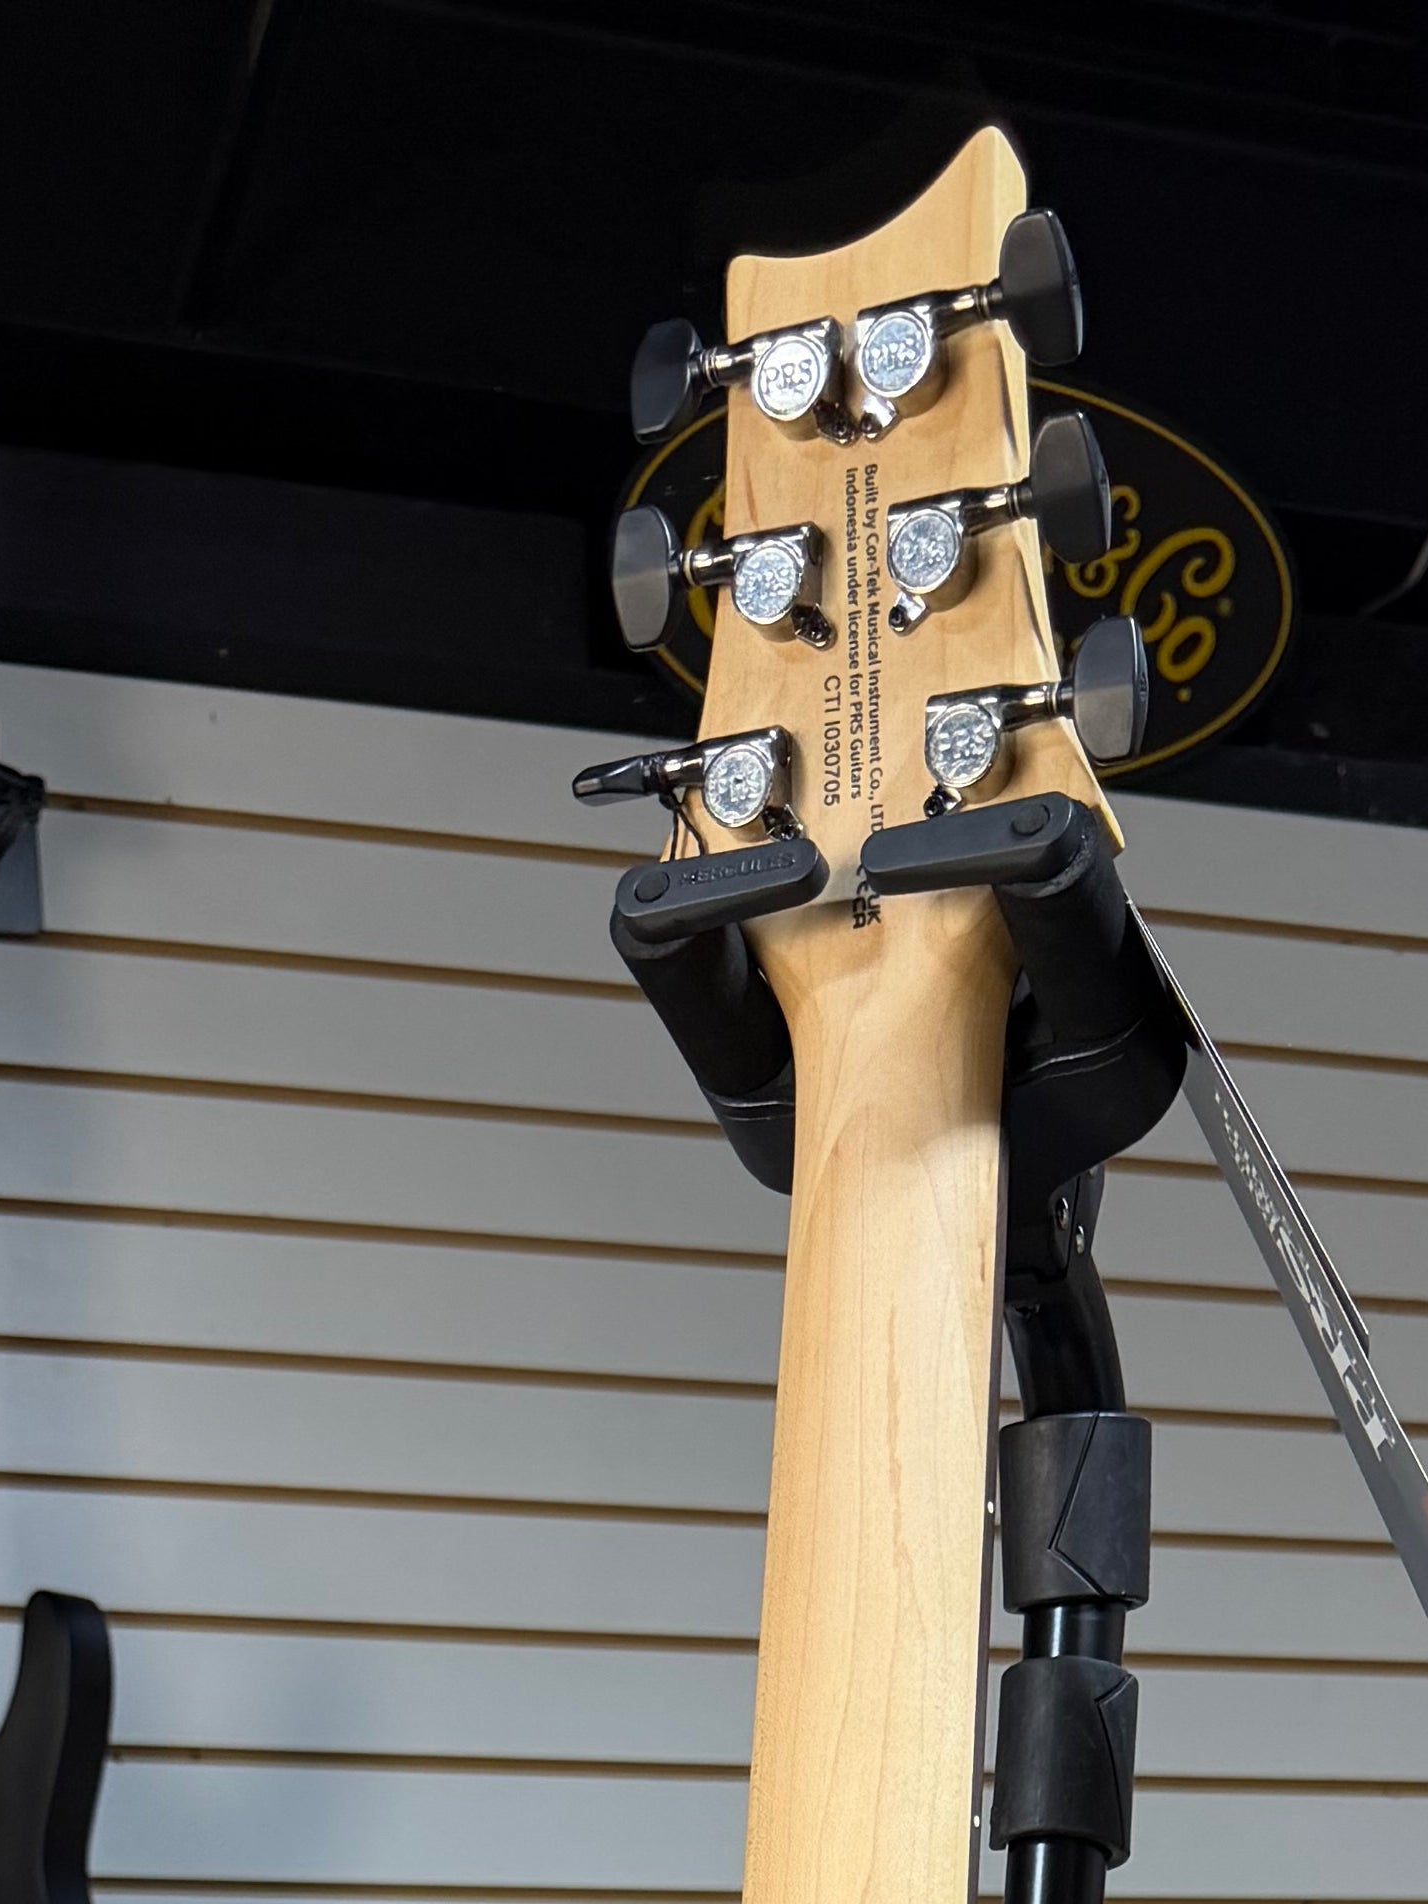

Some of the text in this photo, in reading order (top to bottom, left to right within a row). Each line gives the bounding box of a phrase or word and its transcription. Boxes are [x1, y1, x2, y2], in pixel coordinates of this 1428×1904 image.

[762, 358, 813, 396] PRS
[864, 463, 879, 503] Built
[862, 508, 879, 531] by
[865, 532, 881, 599] Cor-Tek
[846, 467, 865, 800] Indonesia under license for PRS Guitars
[867, 601, 882, 666] Musical
[868, 669, 883, 764] Instrument
[867, 766, 884, 801] Co.,
